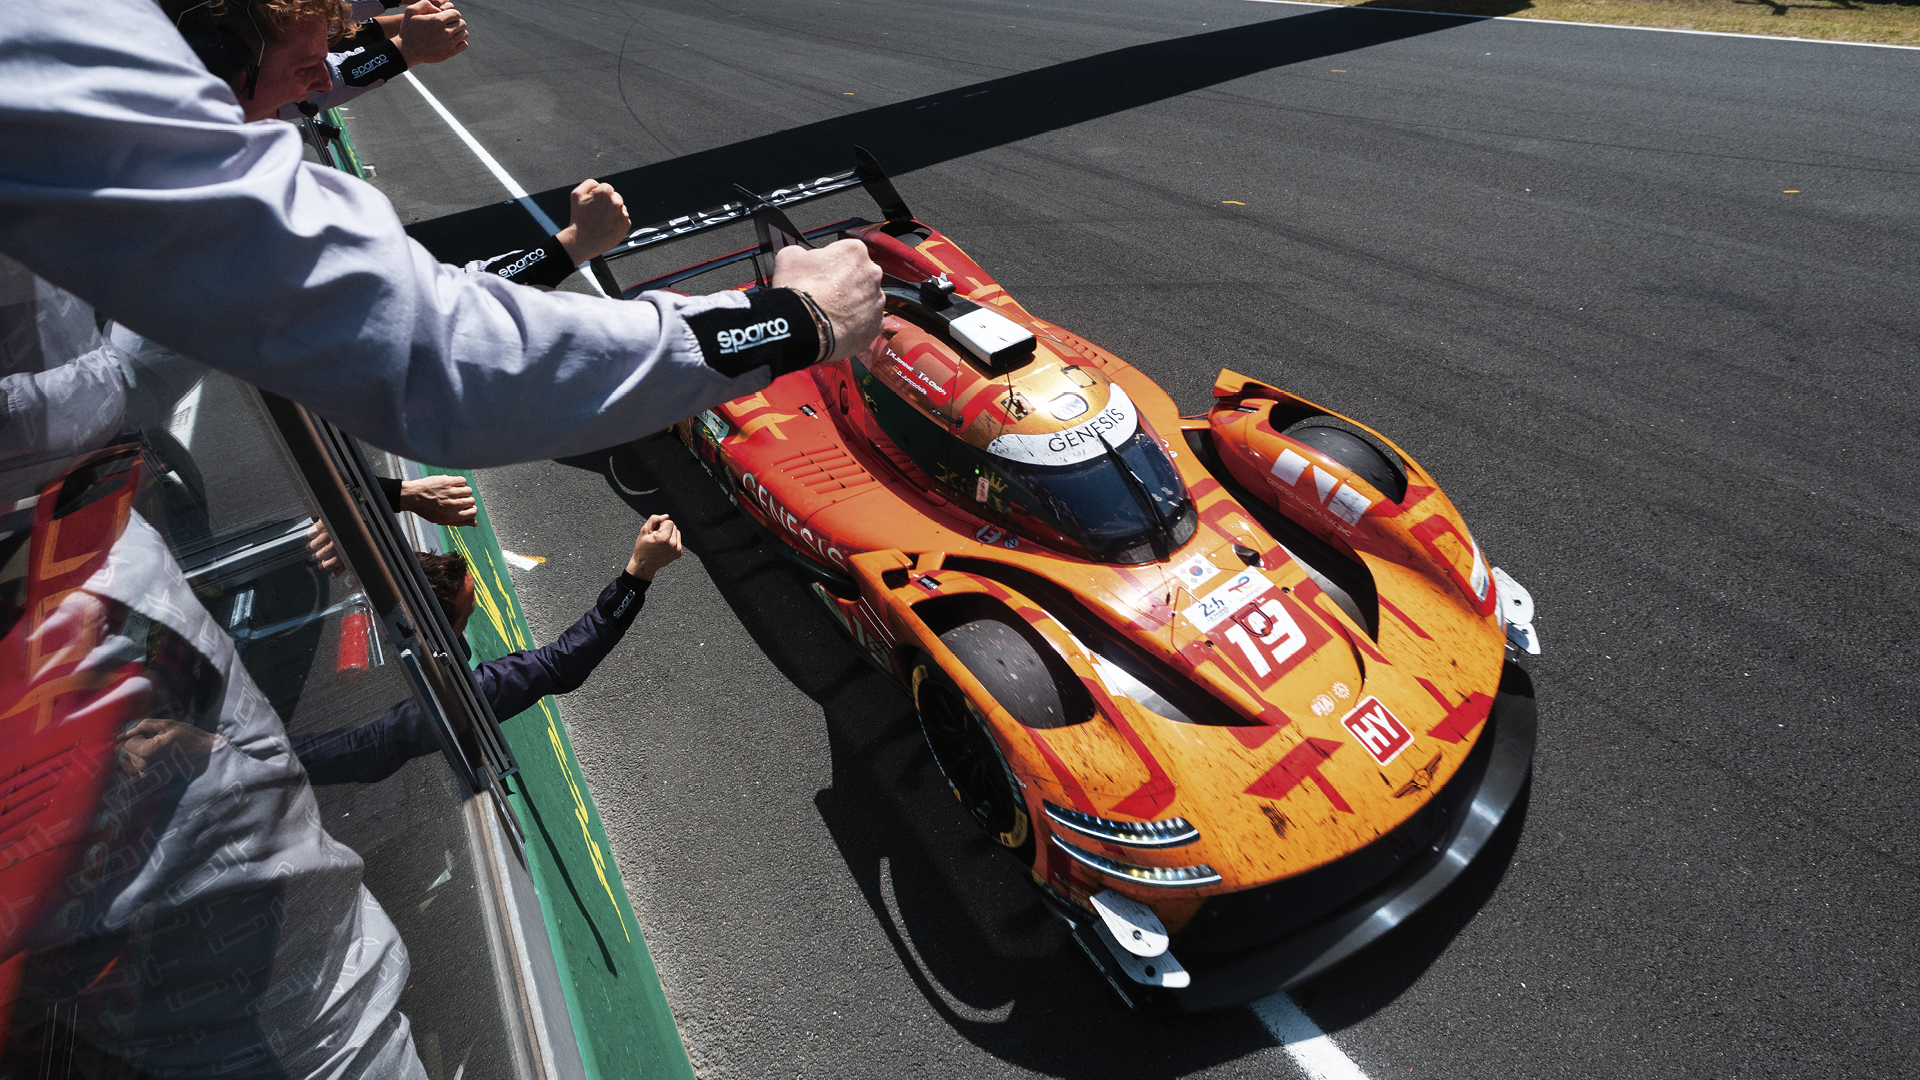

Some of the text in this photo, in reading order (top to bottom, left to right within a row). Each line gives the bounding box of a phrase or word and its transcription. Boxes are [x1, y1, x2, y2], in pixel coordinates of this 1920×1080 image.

[351, 53, 388, 79] sparco
[628, 177, 846, 247] GENSIS
[498, 248, 547, 279] sparco
[717, 317, 791, 354] sparco
[1048, 408, 1125, 453] GENESIS
[1224, 599, 1307, 678] 19
[1351, 704, 1400, 755] HY
